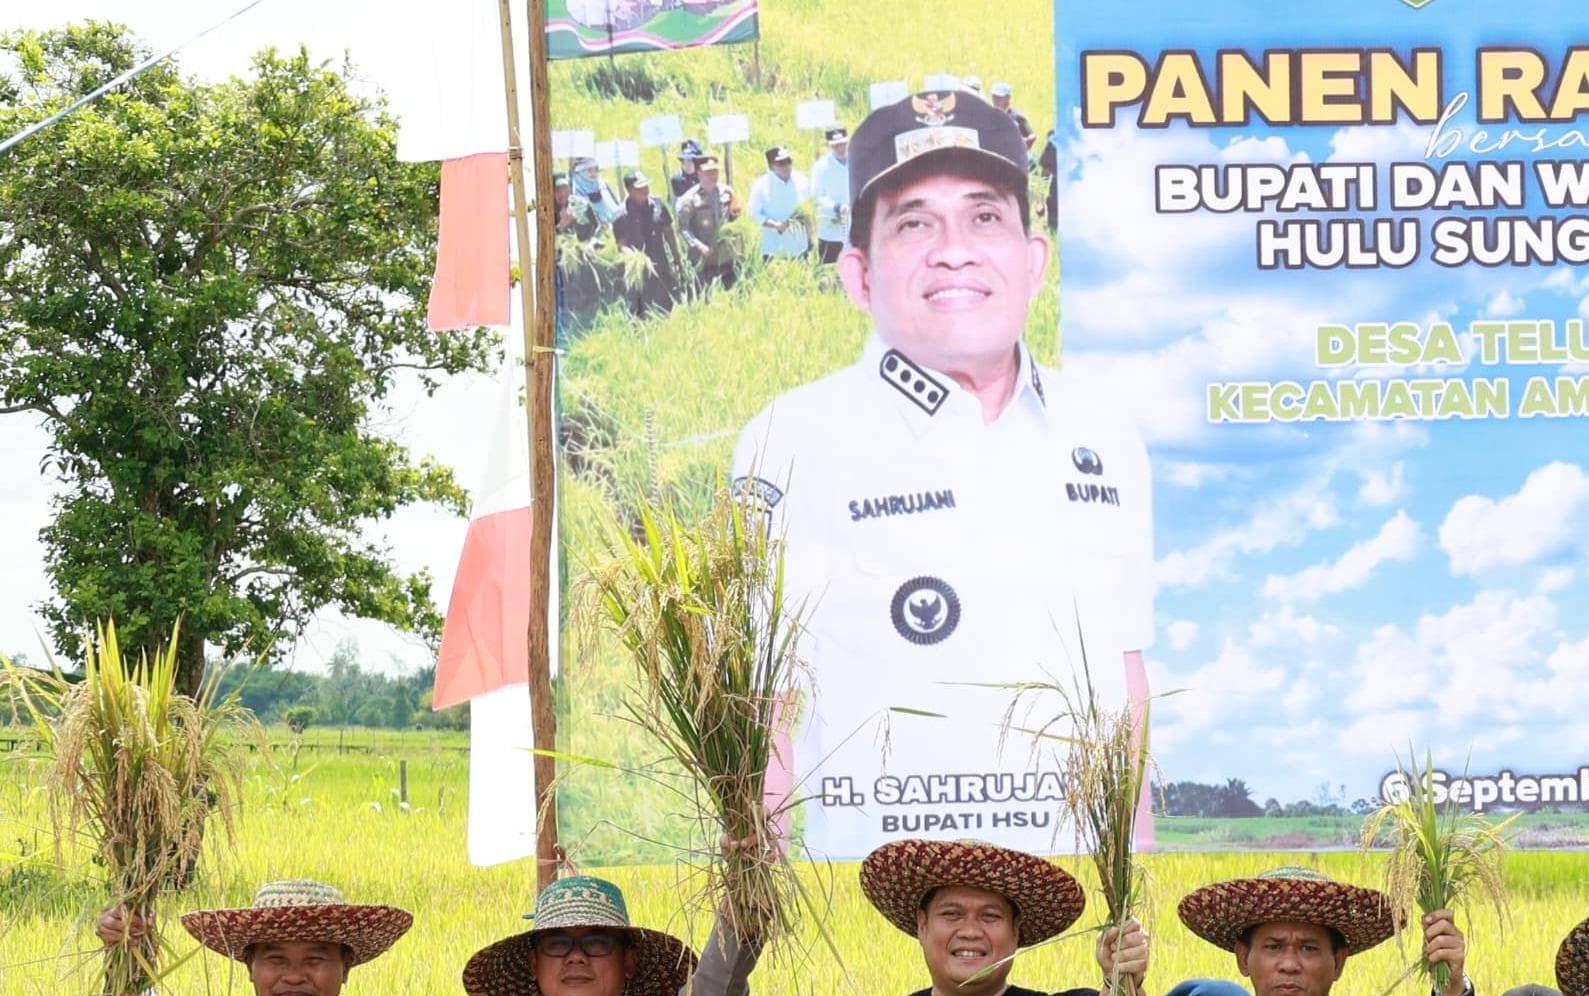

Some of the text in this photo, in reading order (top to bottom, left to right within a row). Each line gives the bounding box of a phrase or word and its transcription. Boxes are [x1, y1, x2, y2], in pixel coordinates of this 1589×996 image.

[1081, 48, 1442, 128] PANEN
[1155, 162, 1377, 214] BUPATI
[1391, 161, 1525, 210] DAN
[1257, 218, 1419, 271] HULU
[1316, 321, 1465, 367] DESA
[1207, 376, 1510, 423] KECAMATAN
[848, 489, 957, 522] SAHRUJANI
[1065, 483, 1121, 507] BUPATI
[822, 771, 1067, 807] H. SAHRUJA
[882, 810, 1050, 833] BUPATI HSU
